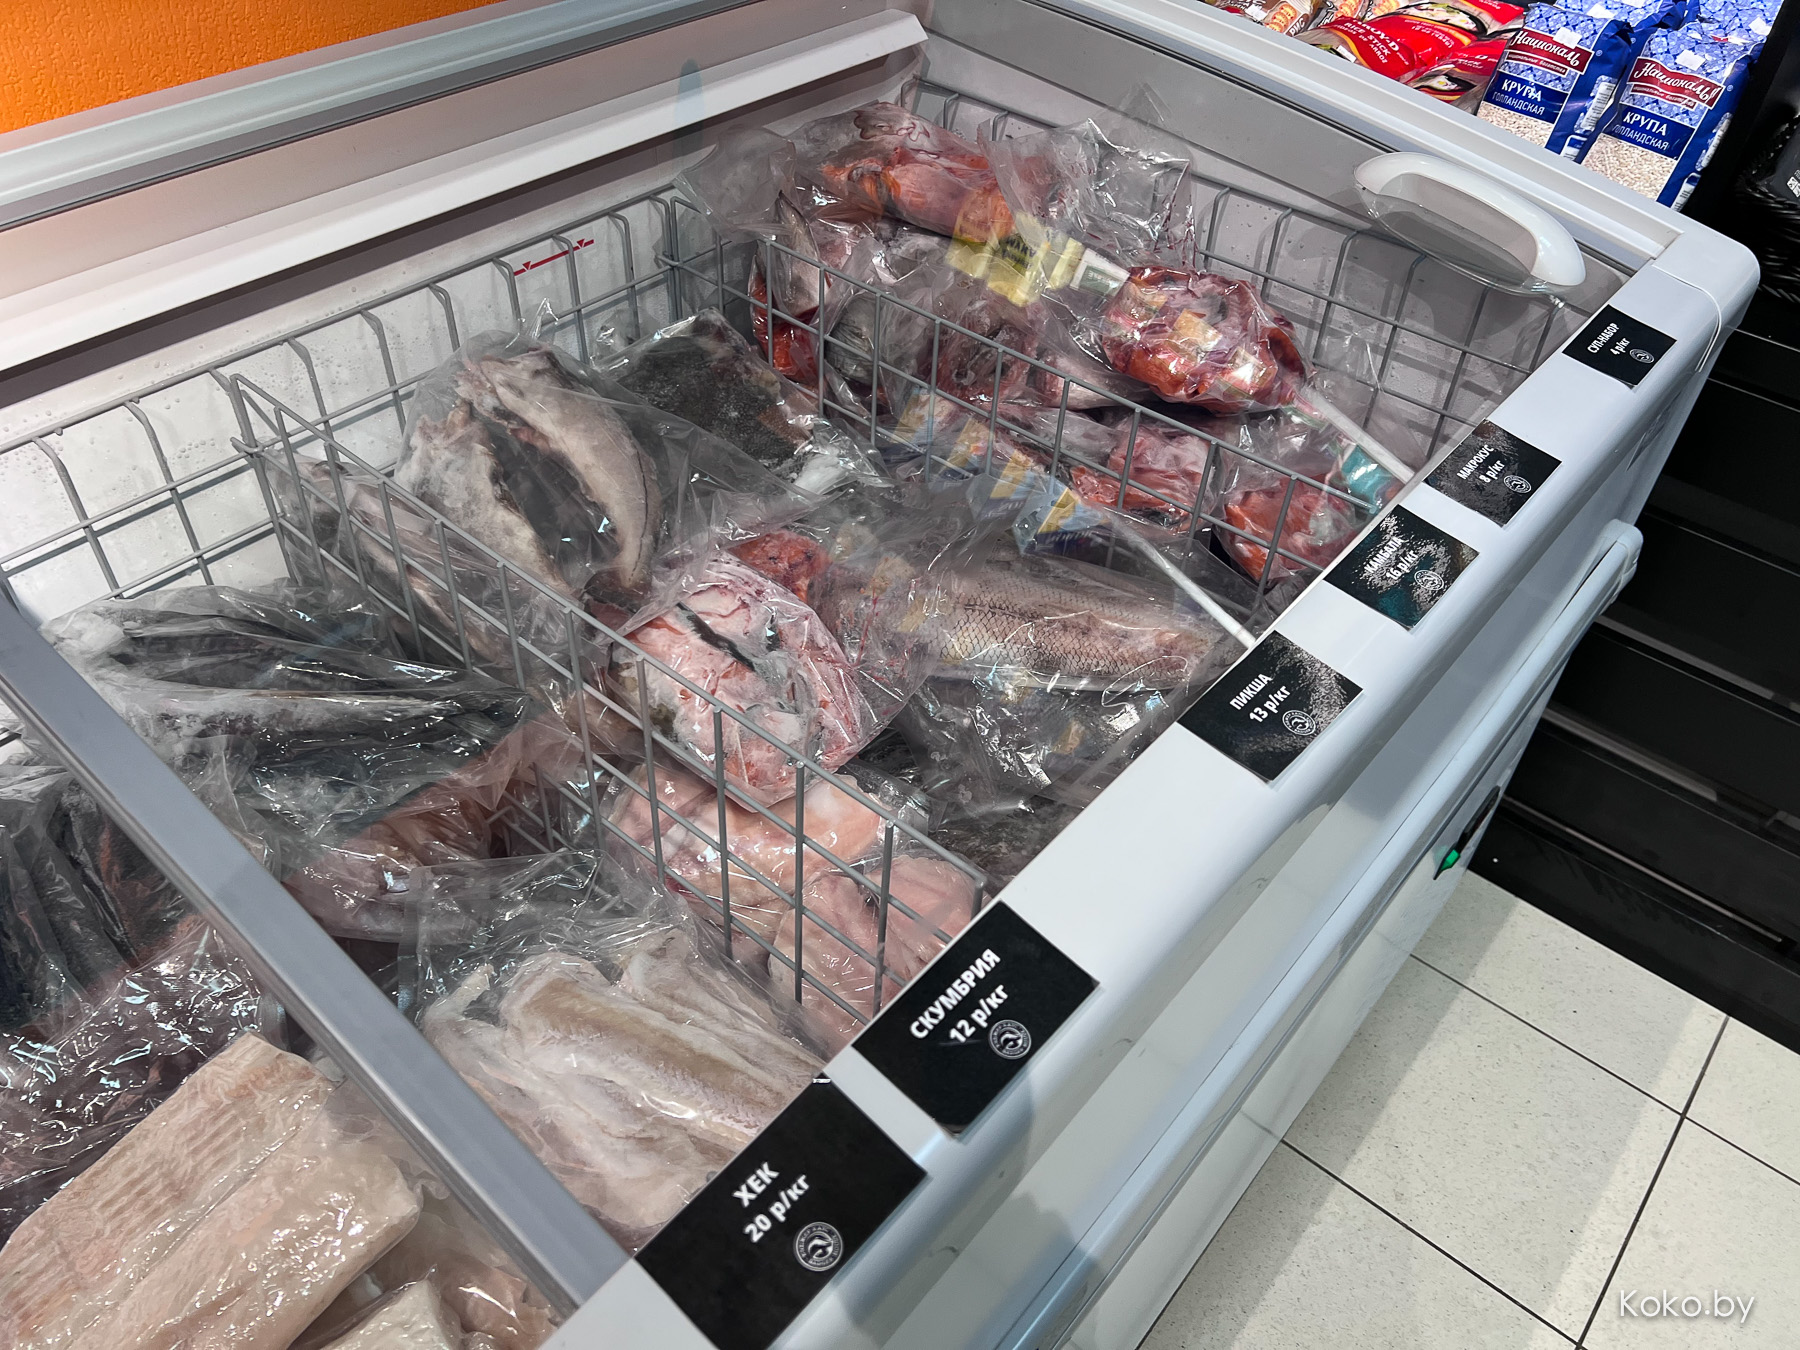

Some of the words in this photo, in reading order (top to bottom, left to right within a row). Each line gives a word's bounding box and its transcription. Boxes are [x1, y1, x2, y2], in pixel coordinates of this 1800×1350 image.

[1344, 22, 1366, 34] RICE
[1367, 34, 1392, 55] STICK
[1369, 43, 1389, 63] ARROZ
[1510, 30, 1583, 67] Националь
[1502, 79, 1543, 102] КРУПА
[1633, 62, 1713, 102] Националь
[1492, 91, 1546, 115] ГОЛЛАНДСКАЯ
[1612, 124, 1669, 151] ГОЛЛАНДСКАЯ
[1623, 112, 1668, 137] КРУПА
[1587, 322, 1620, 354] СУП-НАБОР
[1609, 346, 1618, 356] 4
[1615, 337, 1630, 354] р/кг
[1457, 444, 1495, 480] МАКРОКУС
[1479, 474, 1490, 485] 8
[1487, 459, 1506, 481] р/кг
[1364, 536, 1405, 574] КАМБАЛА
[1386, 566, 1400, 580] 16
[1398, 550, 1419, 577] р/кг
[1229, 673, 1274, 710] ПИКША
[1249, 707, 1269, 723] 13
[1263, 686, 1291, 714] р/кг
[909, 948, 1002, 1039] СКУМБРИЯ
[949, 1018, 976, 1043] 12
[971, 984, 1009, 1026] р/кг
[732, 1161, 780, 1208] ХЕК
[743, 1213, 774, 1245] 20
[770, 1173, 811, 1223] р/кг
